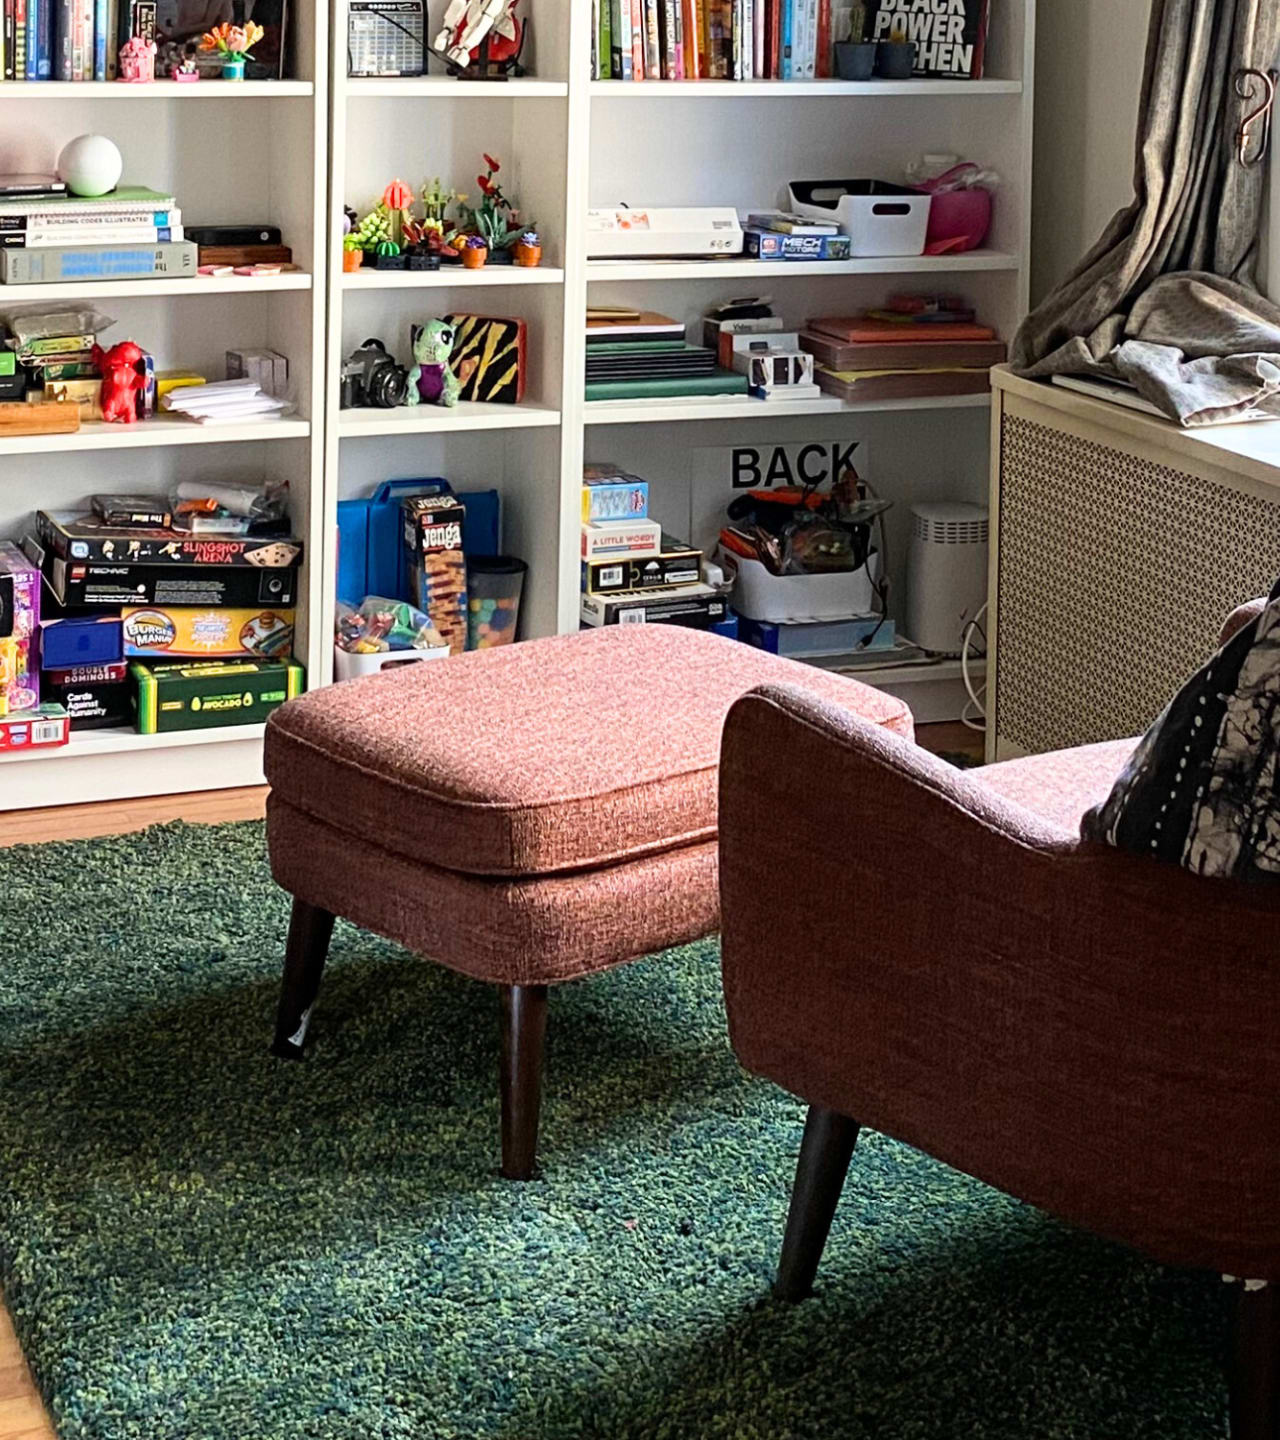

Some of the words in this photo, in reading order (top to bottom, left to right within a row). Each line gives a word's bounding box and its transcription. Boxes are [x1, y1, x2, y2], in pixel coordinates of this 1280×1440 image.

[665, 2, 675, 53] APOTHECARY
[874, 11, 966, 43] POWER
[781, 237, 823, 247] MECH
[781, 245, 820, 253] MOTORS
[732, 442, 860, 489] BACK
[418, 496, 458, 509] Jenga
[131, 514, 149, 523] Mind
[150, 515, 163, 523] The
[423, 523, 462, 550] Jenga
[601, 536, 624, 545] LITTLE
[626, 534, 655, 543] WORDY
[183, 542, 247, 554] SLINGSHOT
[194, 552, 232, 563] ARENA
[89, 567, 130, 575] TECHNIC
[126, 624, 173, 637] BURGER
[136, 633, 173, 646] MANIA
[71, 666, 109, 676] DOUBLE
[65, 672, 117, 683] DOMINOES
[67, 692, 94, 702] Cards
[67, 700, 100, 710] Against
[202, 699, 242, 710] AVOCADO
[67, 708, 107, 719] Humanity
